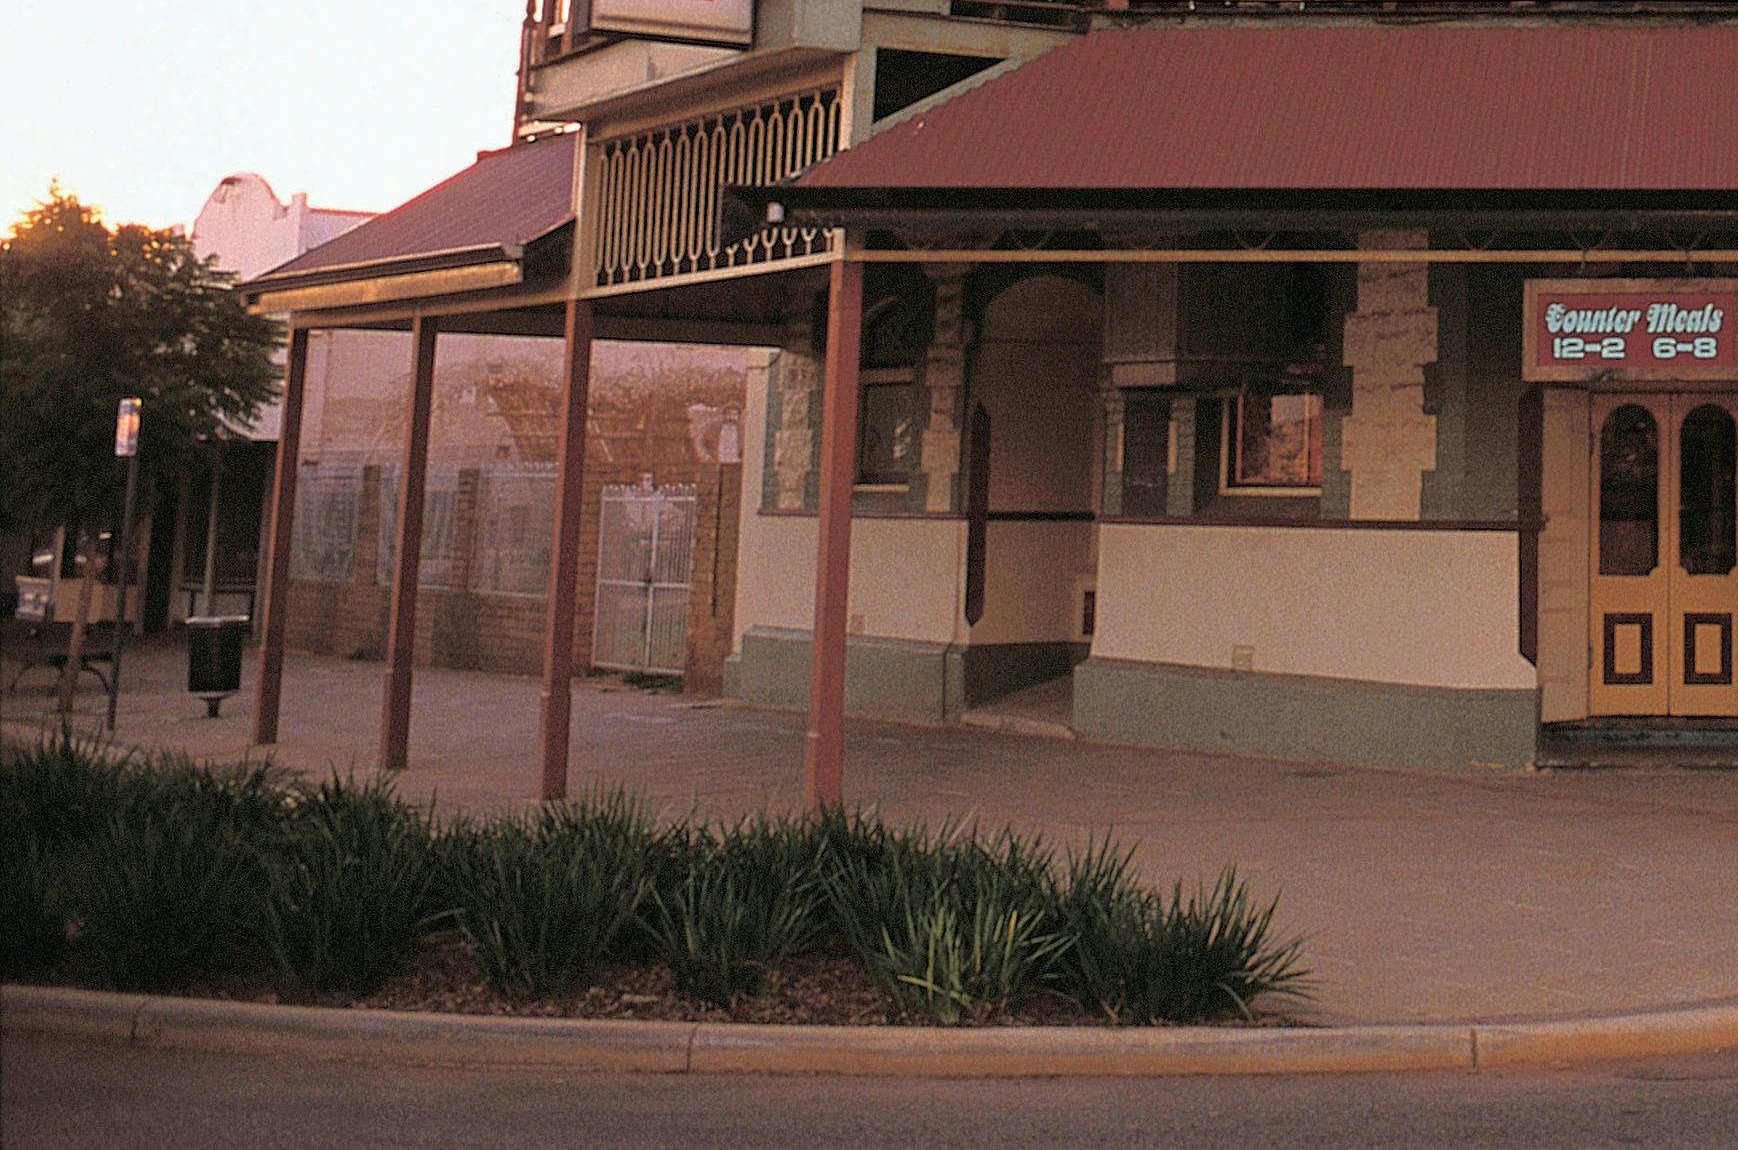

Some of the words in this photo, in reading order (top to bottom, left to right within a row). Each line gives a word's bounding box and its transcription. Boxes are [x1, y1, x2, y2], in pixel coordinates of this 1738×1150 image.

[1545, 303, 1641, 333] Counter
[1646, 303, 1724, 333] Meals
[1553, 337, 1626, 358] 12-2
[1652, 337, 1717, 358] 6-8
